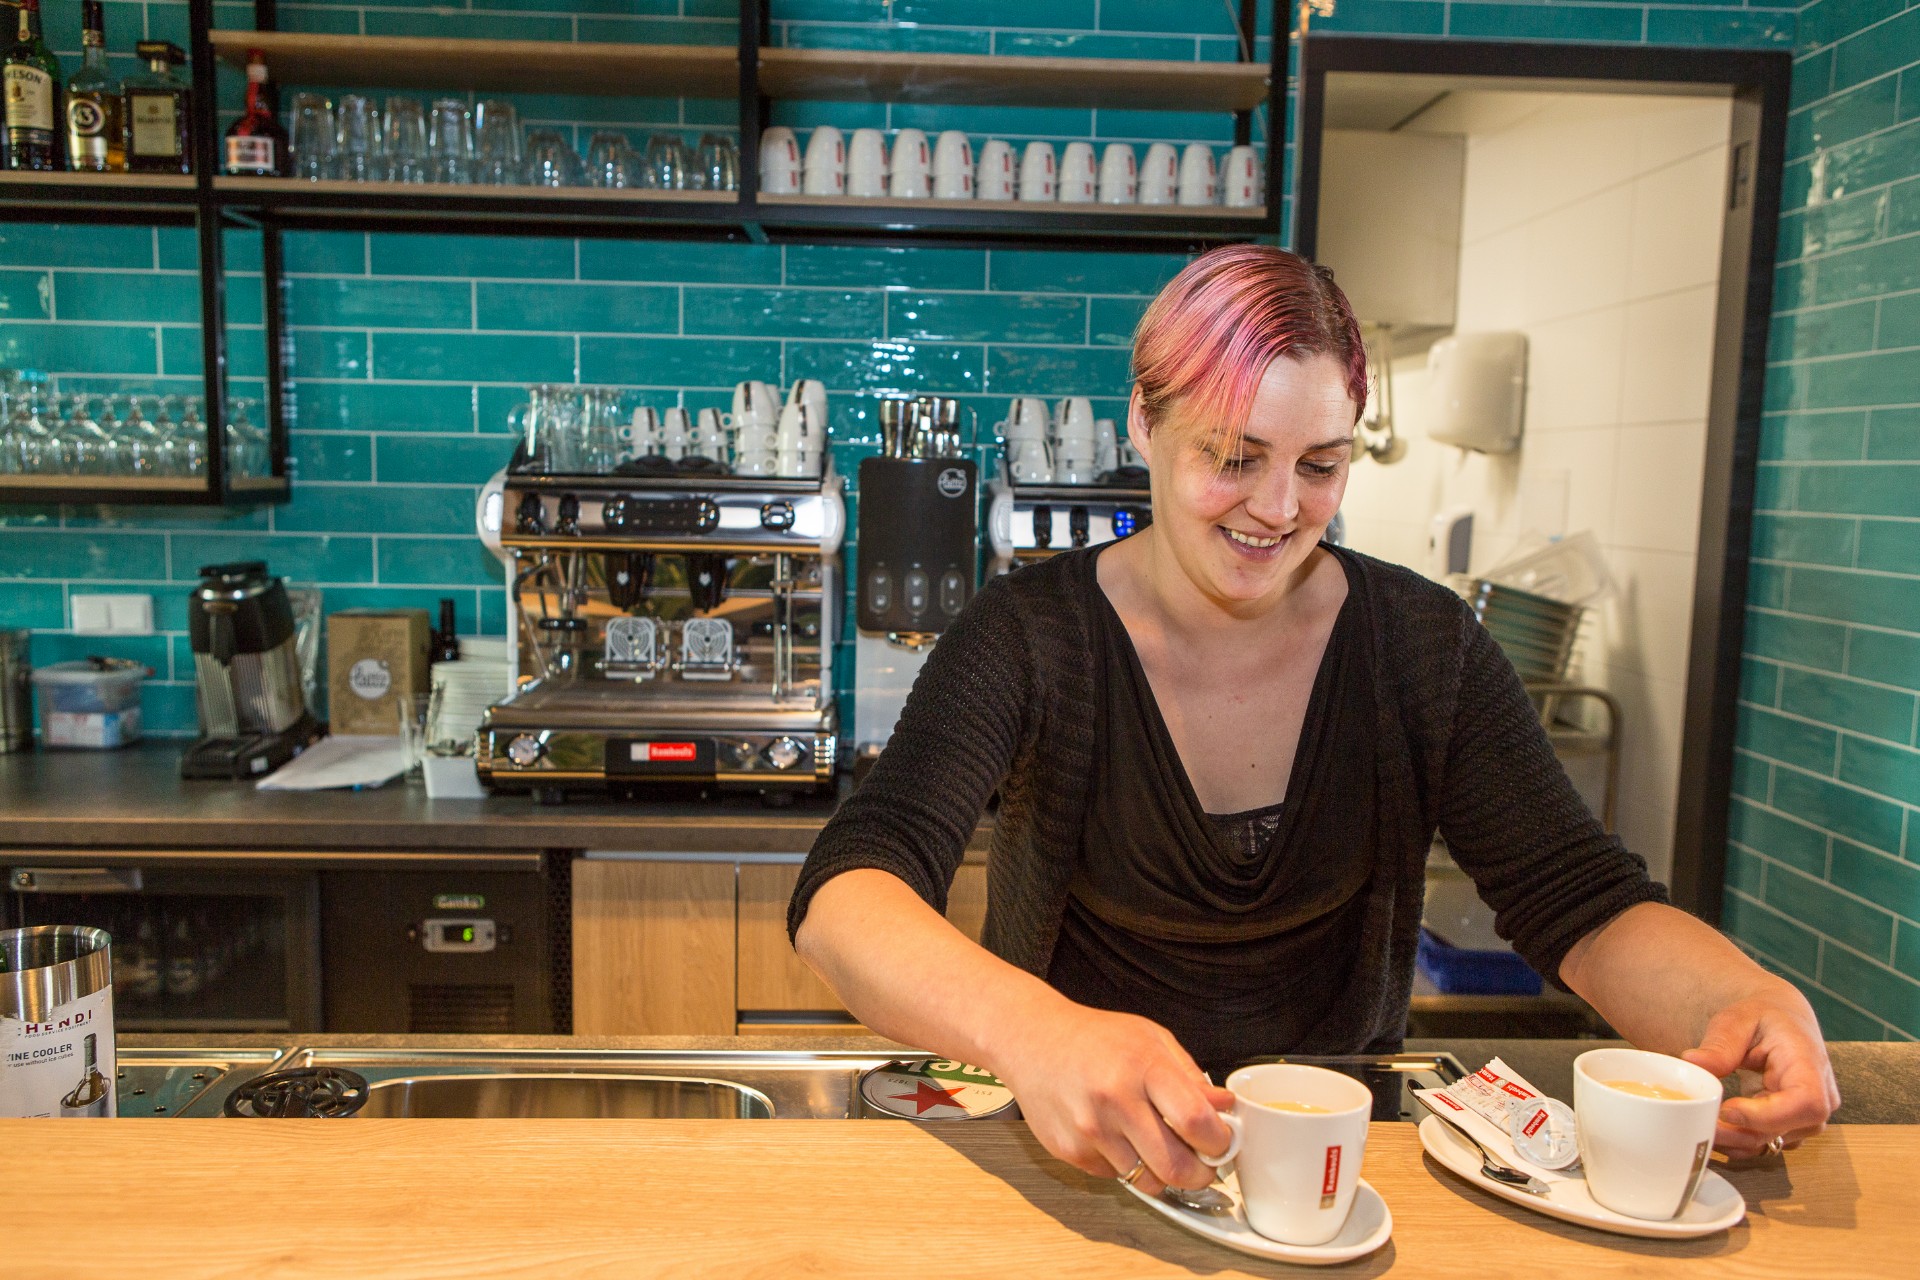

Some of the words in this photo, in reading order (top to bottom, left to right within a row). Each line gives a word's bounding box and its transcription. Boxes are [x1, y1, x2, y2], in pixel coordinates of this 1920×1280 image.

[26, 1009, 92, 1034] HENDI
[32, 1043, 73, 1059] COOLER
[25, 1058, 48, 1066] without
